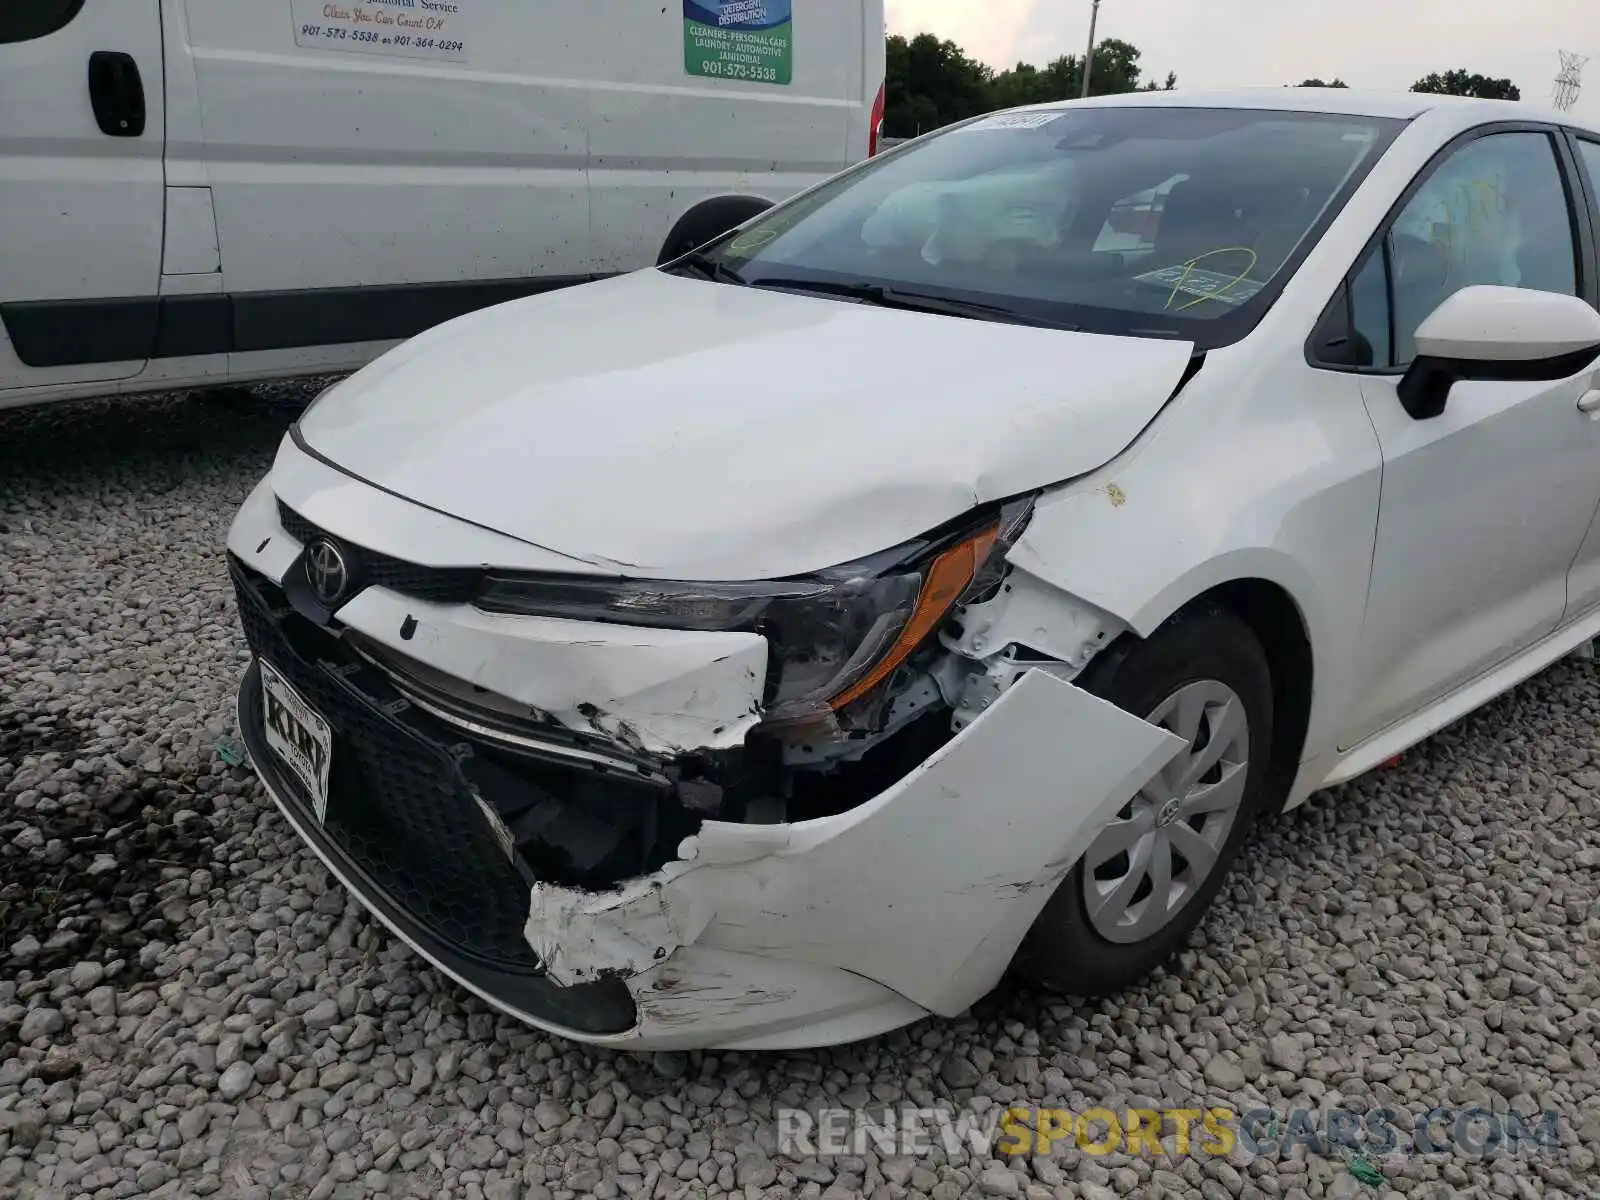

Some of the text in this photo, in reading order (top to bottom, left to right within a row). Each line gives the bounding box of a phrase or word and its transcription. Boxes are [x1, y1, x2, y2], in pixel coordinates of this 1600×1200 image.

[421, 0, 459, 13] Service
[723, 0, 761, 13] DETERGENT
[353, 8, 372, 24] You
[375, 11, 393, 25] Can
[397, 13, 424, 28] Count
[719, 8, 767, 25] DISTRIBUTION
[302, 24, 379, 43] 901-573-5538
[393, 35, 463, 51] 901-364-0294
[690, 27, 787, 47] CLEANERS PERSONAL CARE
[695, 38, 782, 57] LAUNDRY AUTOMOTIVE
[720, 52, 760, 64] JANITORIAL
[703, 61, 776, 80] 901-573-5538
